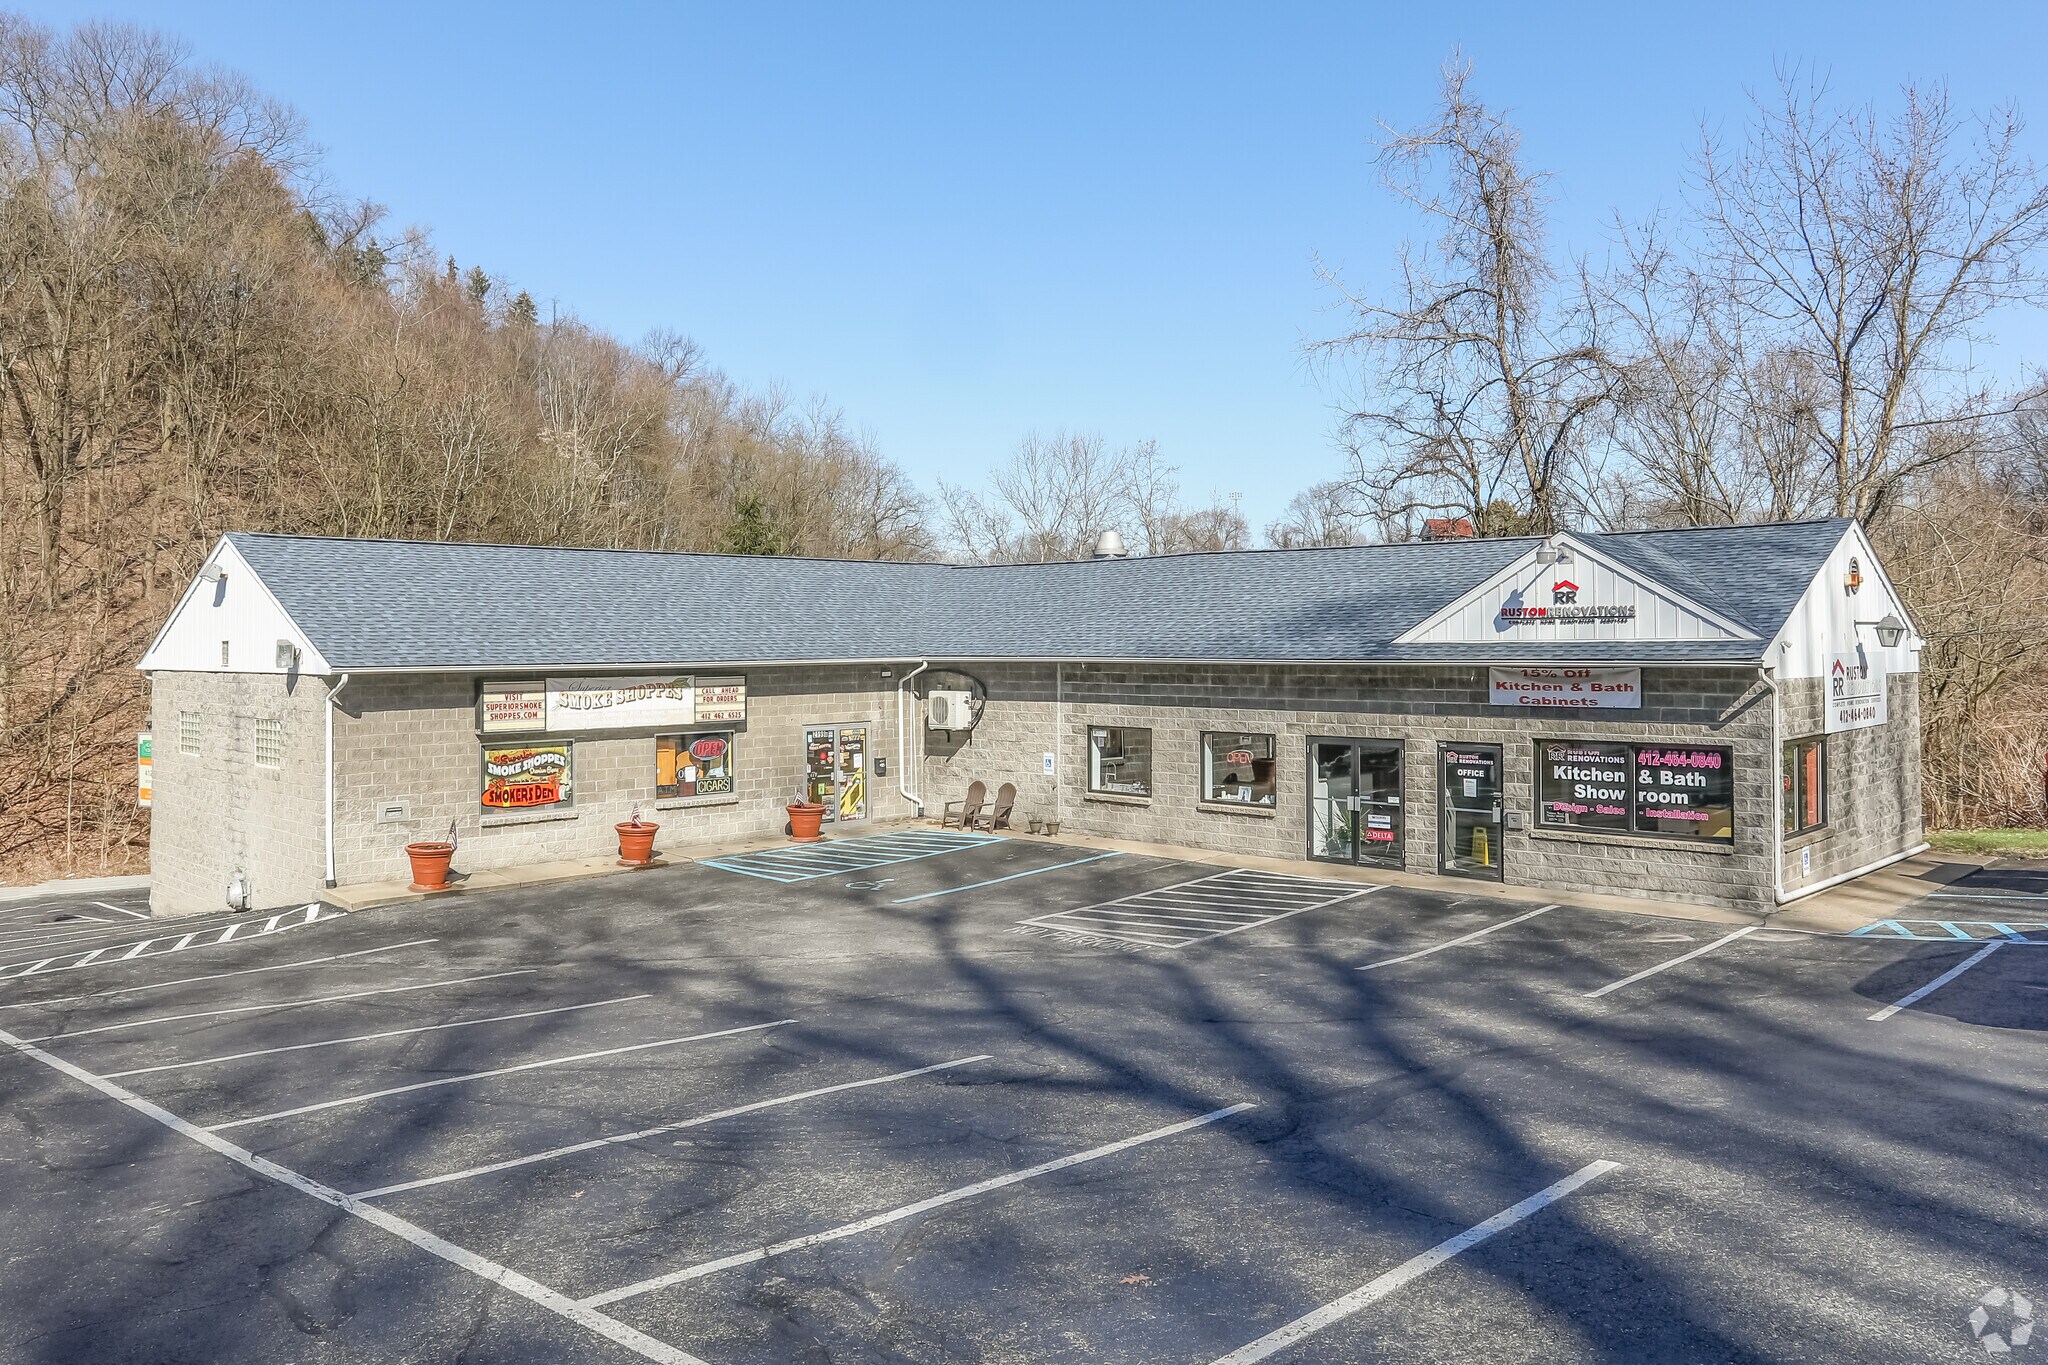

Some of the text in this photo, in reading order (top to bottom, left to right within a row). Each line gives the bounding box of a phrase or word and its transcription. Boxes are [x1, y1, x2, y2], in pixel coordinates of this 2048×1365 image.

[1555, 591, 1577, 605] RR
[1521, 668, 1592, 678] 15% Off
[1495, 681, 1634, 692] Kitchen & Bath
[504, 693, 523, 701] VISIT
[559, 682, 683, 710] SMOKE SHOPPES
[1518, 695, 1599, 707] Cabinets
[486, 702, 542, 711] SUPERIORSMOKE
[490, 711, 538, 721] SHOPPES.COM
[694, 741, 725, 757] OPEN
[1227, 752, 1251, 764] OPEN
[1567, 755, 1625, 764] RENOVATIONS
[1638, 750, 1722, 769] 412-464-0840
[487, 753, 566, 776] SMOKE SHOPPES
[1457, 768, 1485, 777] OFFICE
[1553, 765, 1707, 787] Kitchen & Bath
[698, 778, 729, 793] CIGARS
[1574, 784, 1689, 804] Show room
[1553, 801, 1588, 814] Design
[1596, 804, 1626, 815] Sales
[1645, 807, 1709, 821] Installation
[1372, 831, 1392, 839] DELTA
